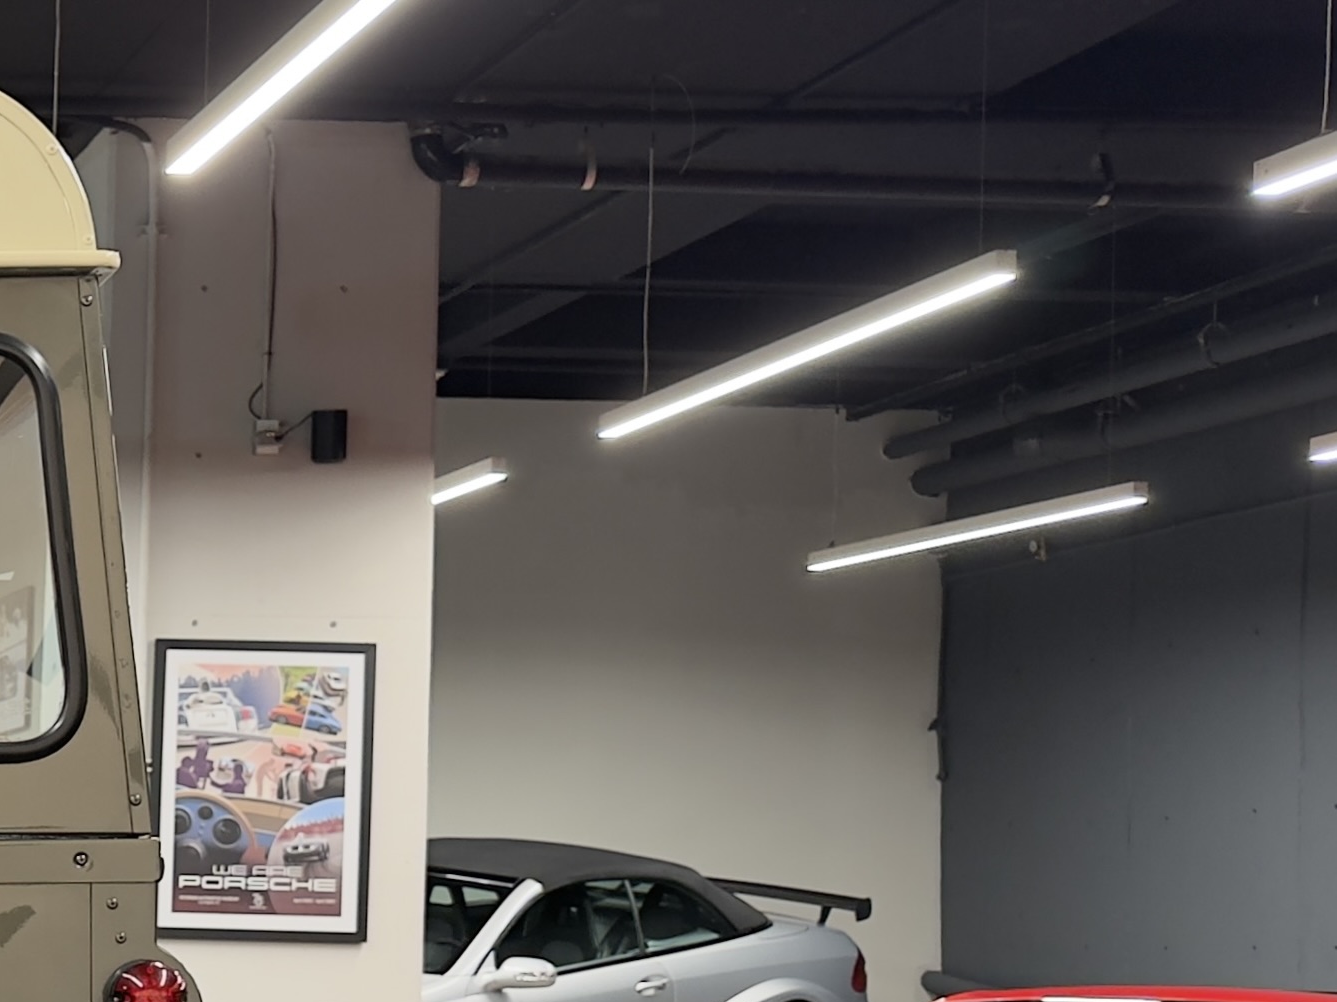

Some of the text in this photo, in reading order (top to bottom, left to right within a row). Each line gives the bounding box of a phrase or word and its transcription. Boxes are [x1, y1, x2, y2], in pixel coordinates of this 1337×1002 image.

[212, 864, 303, 878] WE ARE
[178, 874, 336, 892] PORSCHE
